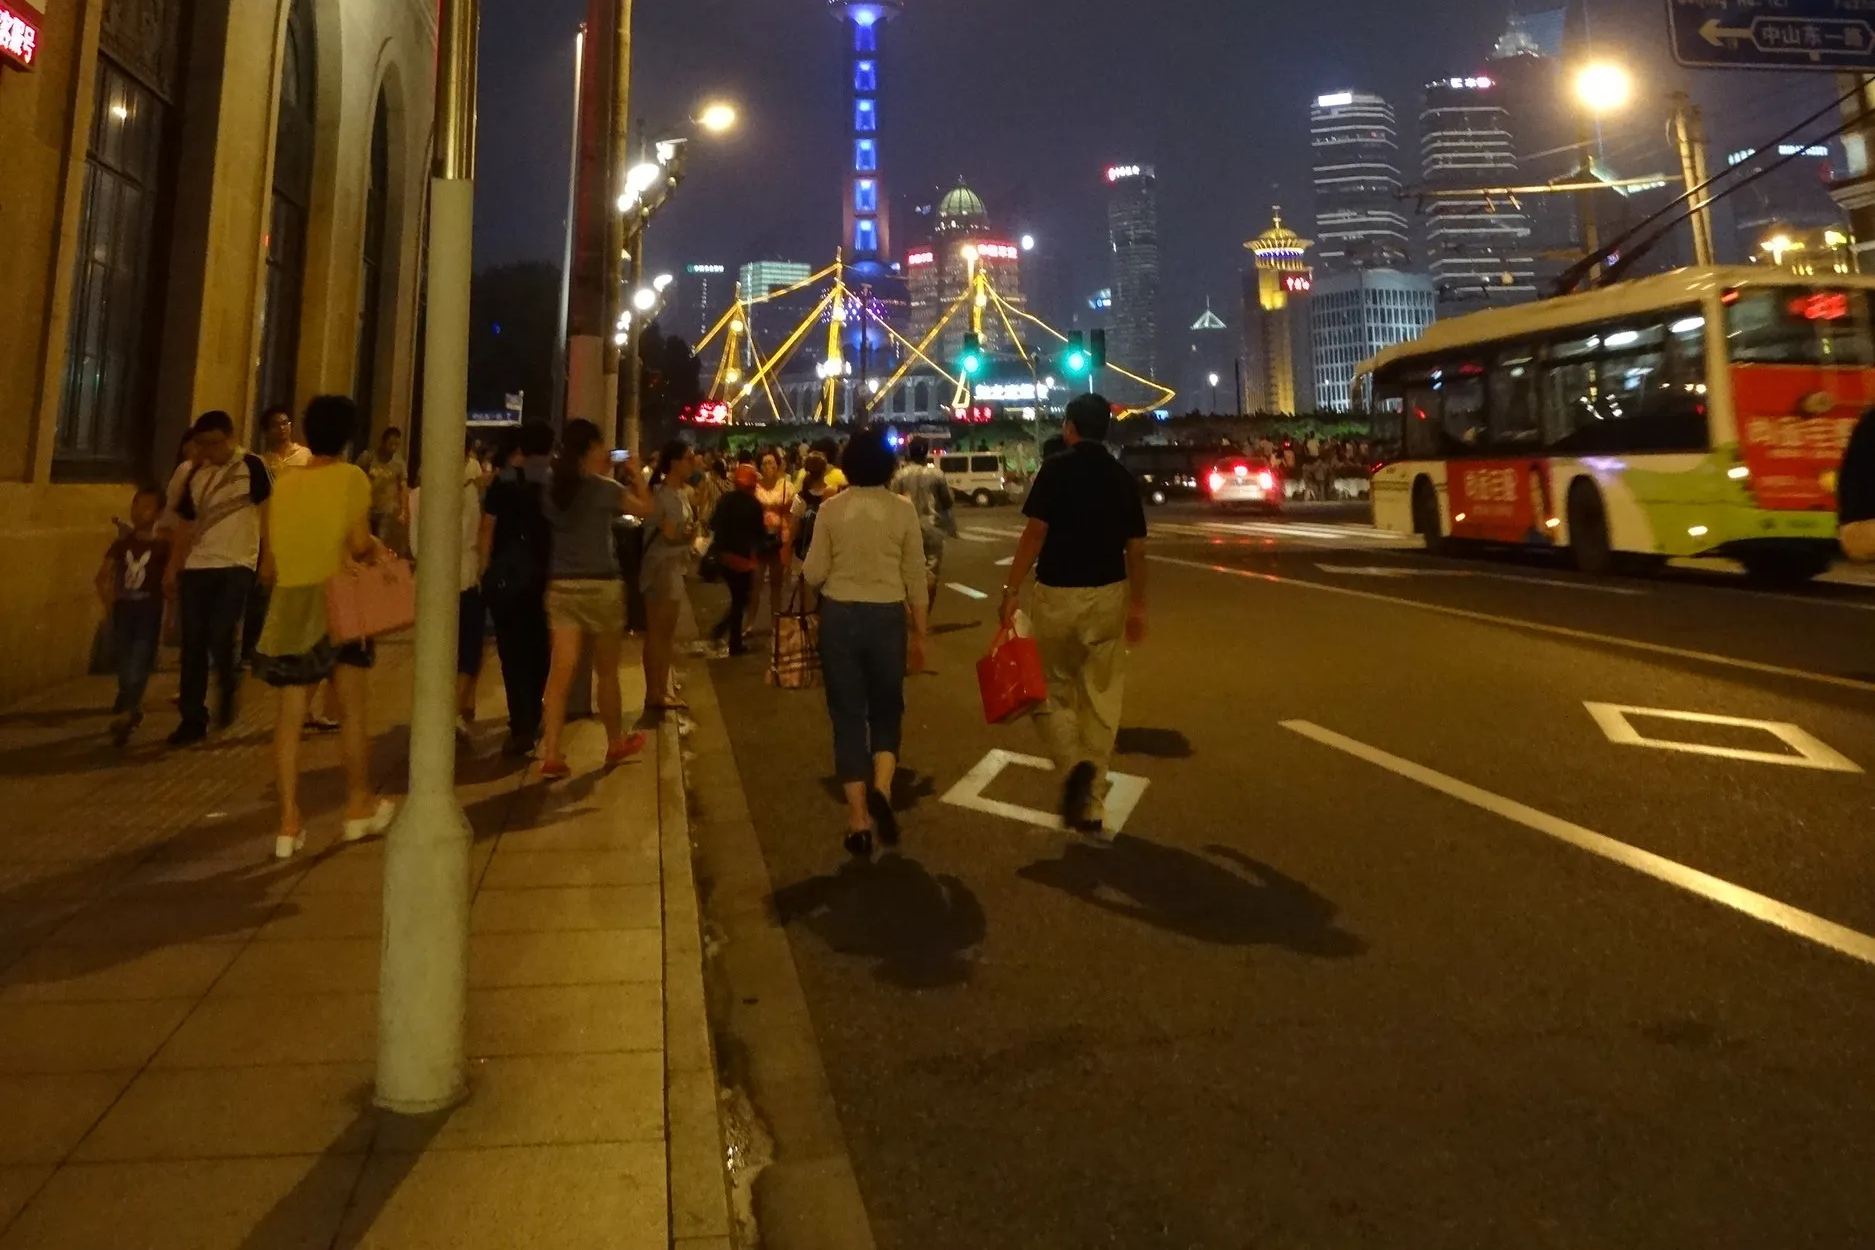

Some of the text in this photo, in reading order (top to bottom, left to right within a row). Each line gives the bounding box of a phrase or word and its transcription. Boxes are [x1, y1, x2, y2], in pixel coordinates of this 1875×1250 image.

[1761, 23, 1864, 48] 中山东一路
